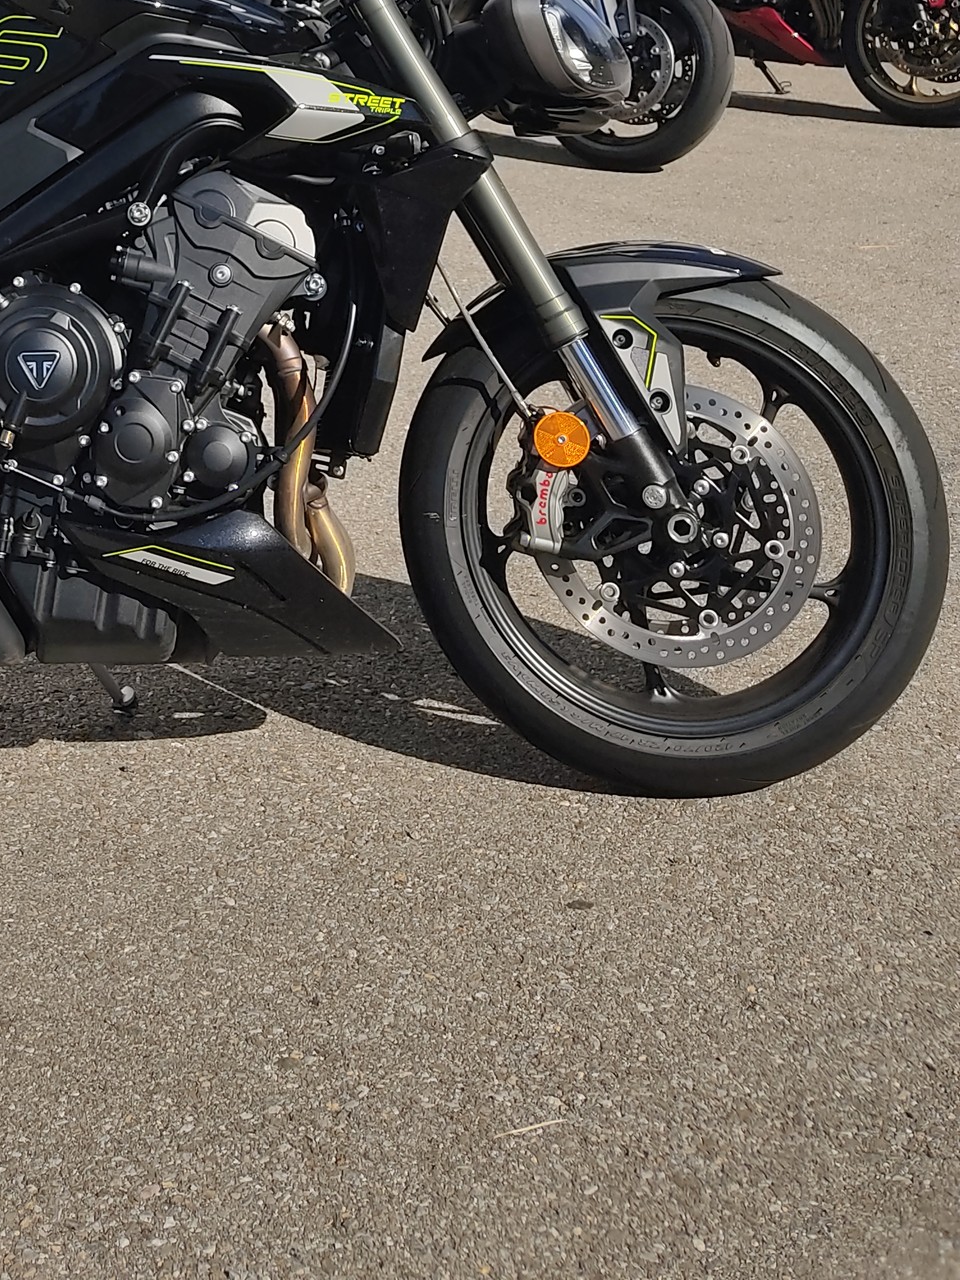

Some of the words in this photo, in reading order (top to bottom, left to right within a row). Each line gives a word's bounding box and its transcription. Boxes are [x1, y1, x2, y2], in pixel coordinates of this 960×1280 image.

[328, 92, 406, 109] STREET
[370, 106, 402, 115] TRIPLE
[140, 558, 157, 568] FOR
[157, 562, 172, 573] THE
[171, 567, 191, 578] RIDE
